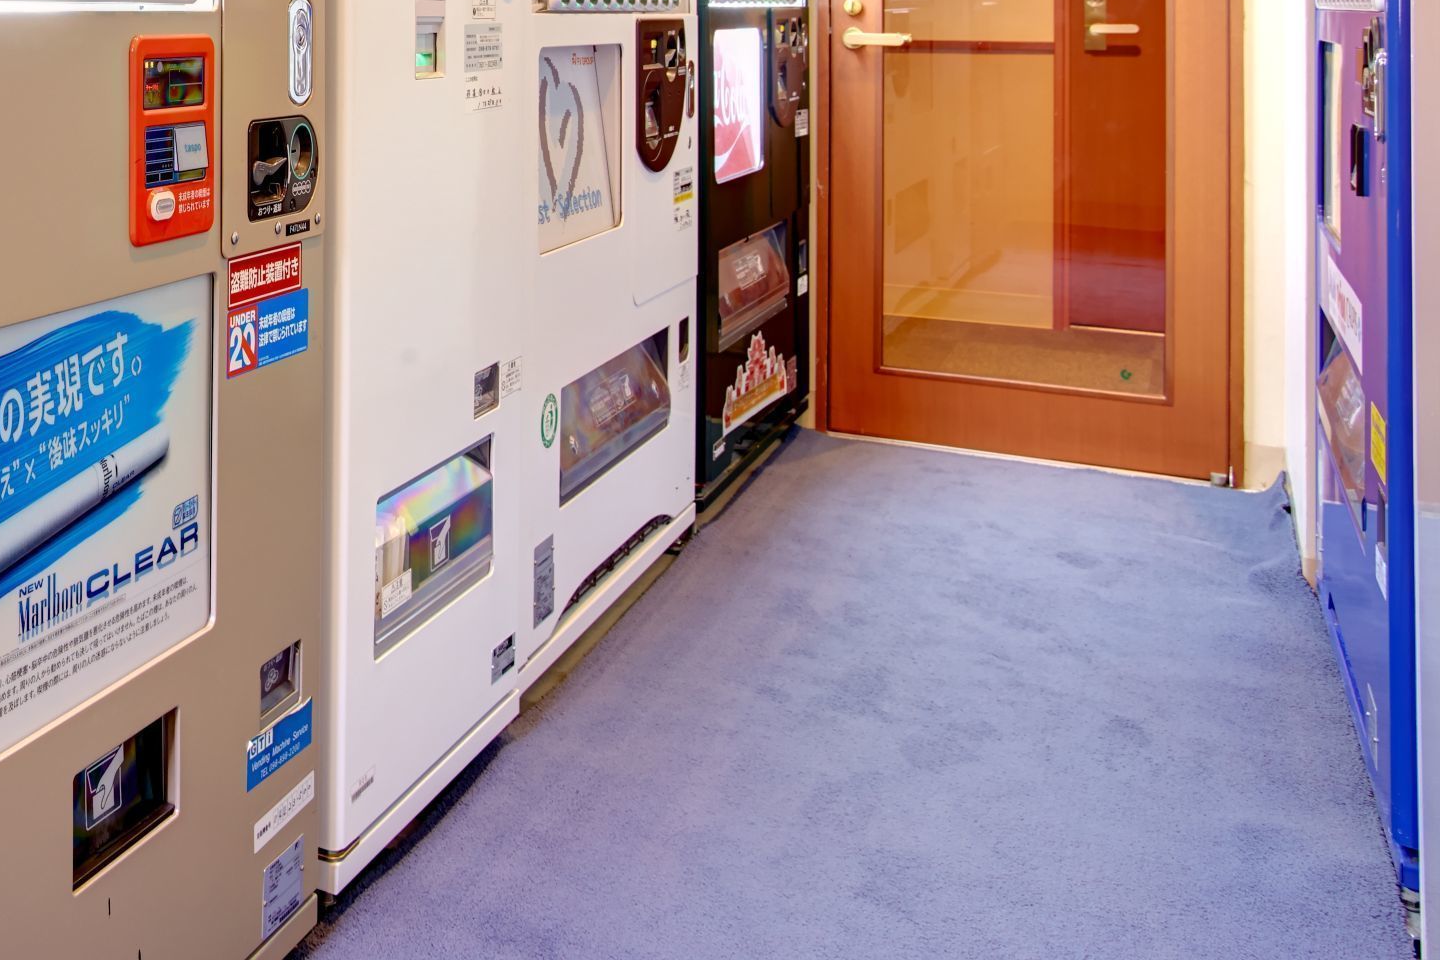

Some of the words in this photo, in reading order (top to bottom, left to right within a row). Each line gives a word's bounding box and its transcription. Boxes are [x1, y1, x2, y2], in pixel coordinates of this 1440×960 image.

[178, 187, 210, 201] 未成年者の喫煙は
[178, 199, 210, 214] 禁じられています
[257, 203, 282, 216] おつり・返却
[230, 256, 299, 294] 盗難防止装置付き
[229, 310, 256, 328] UNDER
[258, 306, 296, 330] 未成年者の喫煙は
[258, 319, 308, 347] 法律で禁じられています
[229, 322, 256, 372] 20
[18, 572, 83, 637] Marlboro
[86, 521, 198, 599] CLEAR
[19, 579, 44, 598] NEW
[251, 752, 271, 772] Vending
[271, 737, 291, 757] Machine
[292, 723, 309, 741] Service
